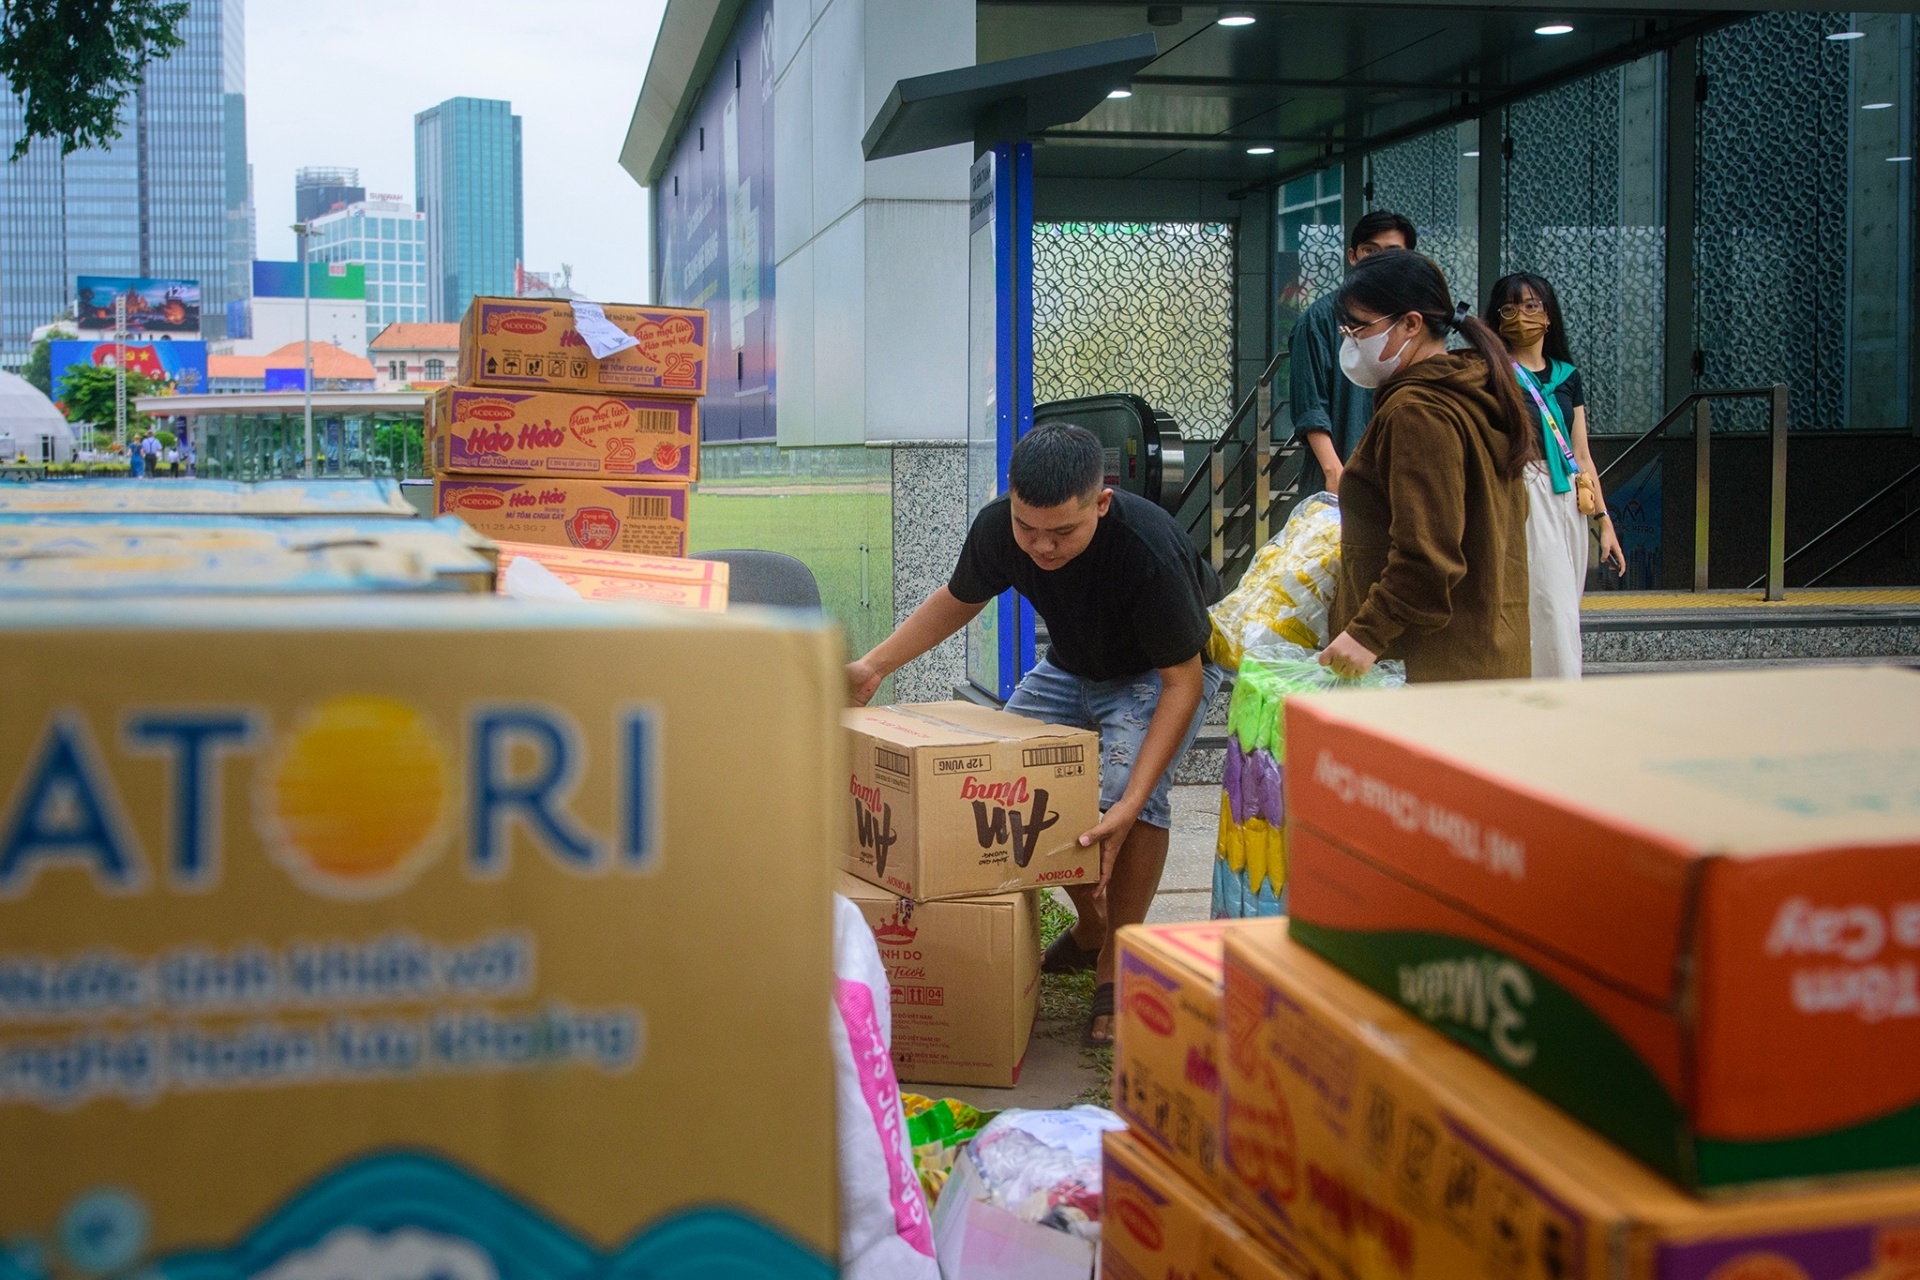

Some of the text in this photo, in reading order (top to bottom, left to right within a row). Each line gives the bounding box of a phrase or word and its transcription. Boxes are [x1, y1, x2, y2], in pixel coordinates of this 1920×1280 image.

[664, 352, 696, 379] 25
[466, 418, 564, 454] Hảo Hảo
[604, 438, 636, 463] 25
[509, 487, 566, 508] Hảo Hảo
[939, 757, 984, 772] 12P VỪNG
[850, 774, 882, 813] Vừng
[960, 776, 1030, 807] Vừng
[856, 798, 898, 878] An
[972, 788, 1060, 868] An
[1766, 894, 1888, 960] Cay
[904, 950, 922, 960] DO
[928, 990, 941, 998] 04
[1490, 961, 1537, 1067] 3
